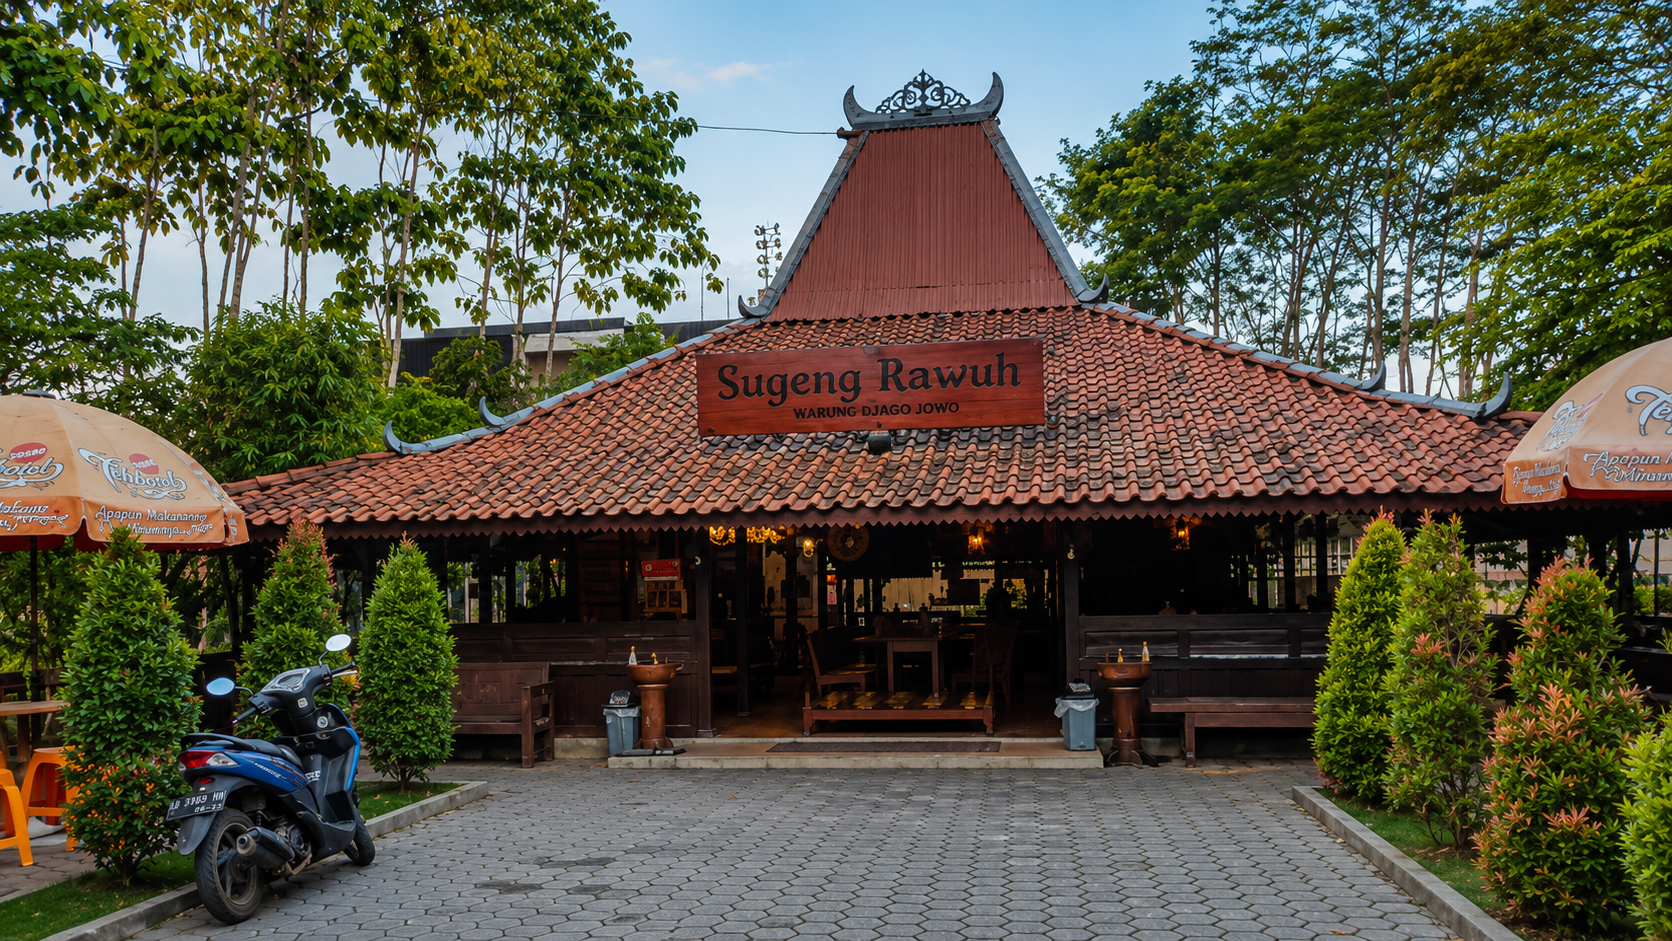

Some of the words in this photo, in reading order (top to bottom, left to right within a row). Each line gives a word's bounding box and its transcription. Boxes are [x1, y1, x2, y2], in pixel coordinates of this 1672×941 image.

[717, 364, 862, 407] Sugeng
[877, 351, 1022, 392] Rawuh
[793, 406, 857, 419] WARUNG
[861, 403, 912, 417] DJAGO
[915, 401, 960, 415] JOWO
[1583, 450, 1661, 477] Apapun
[95, 505, 142, 524] Apapun
